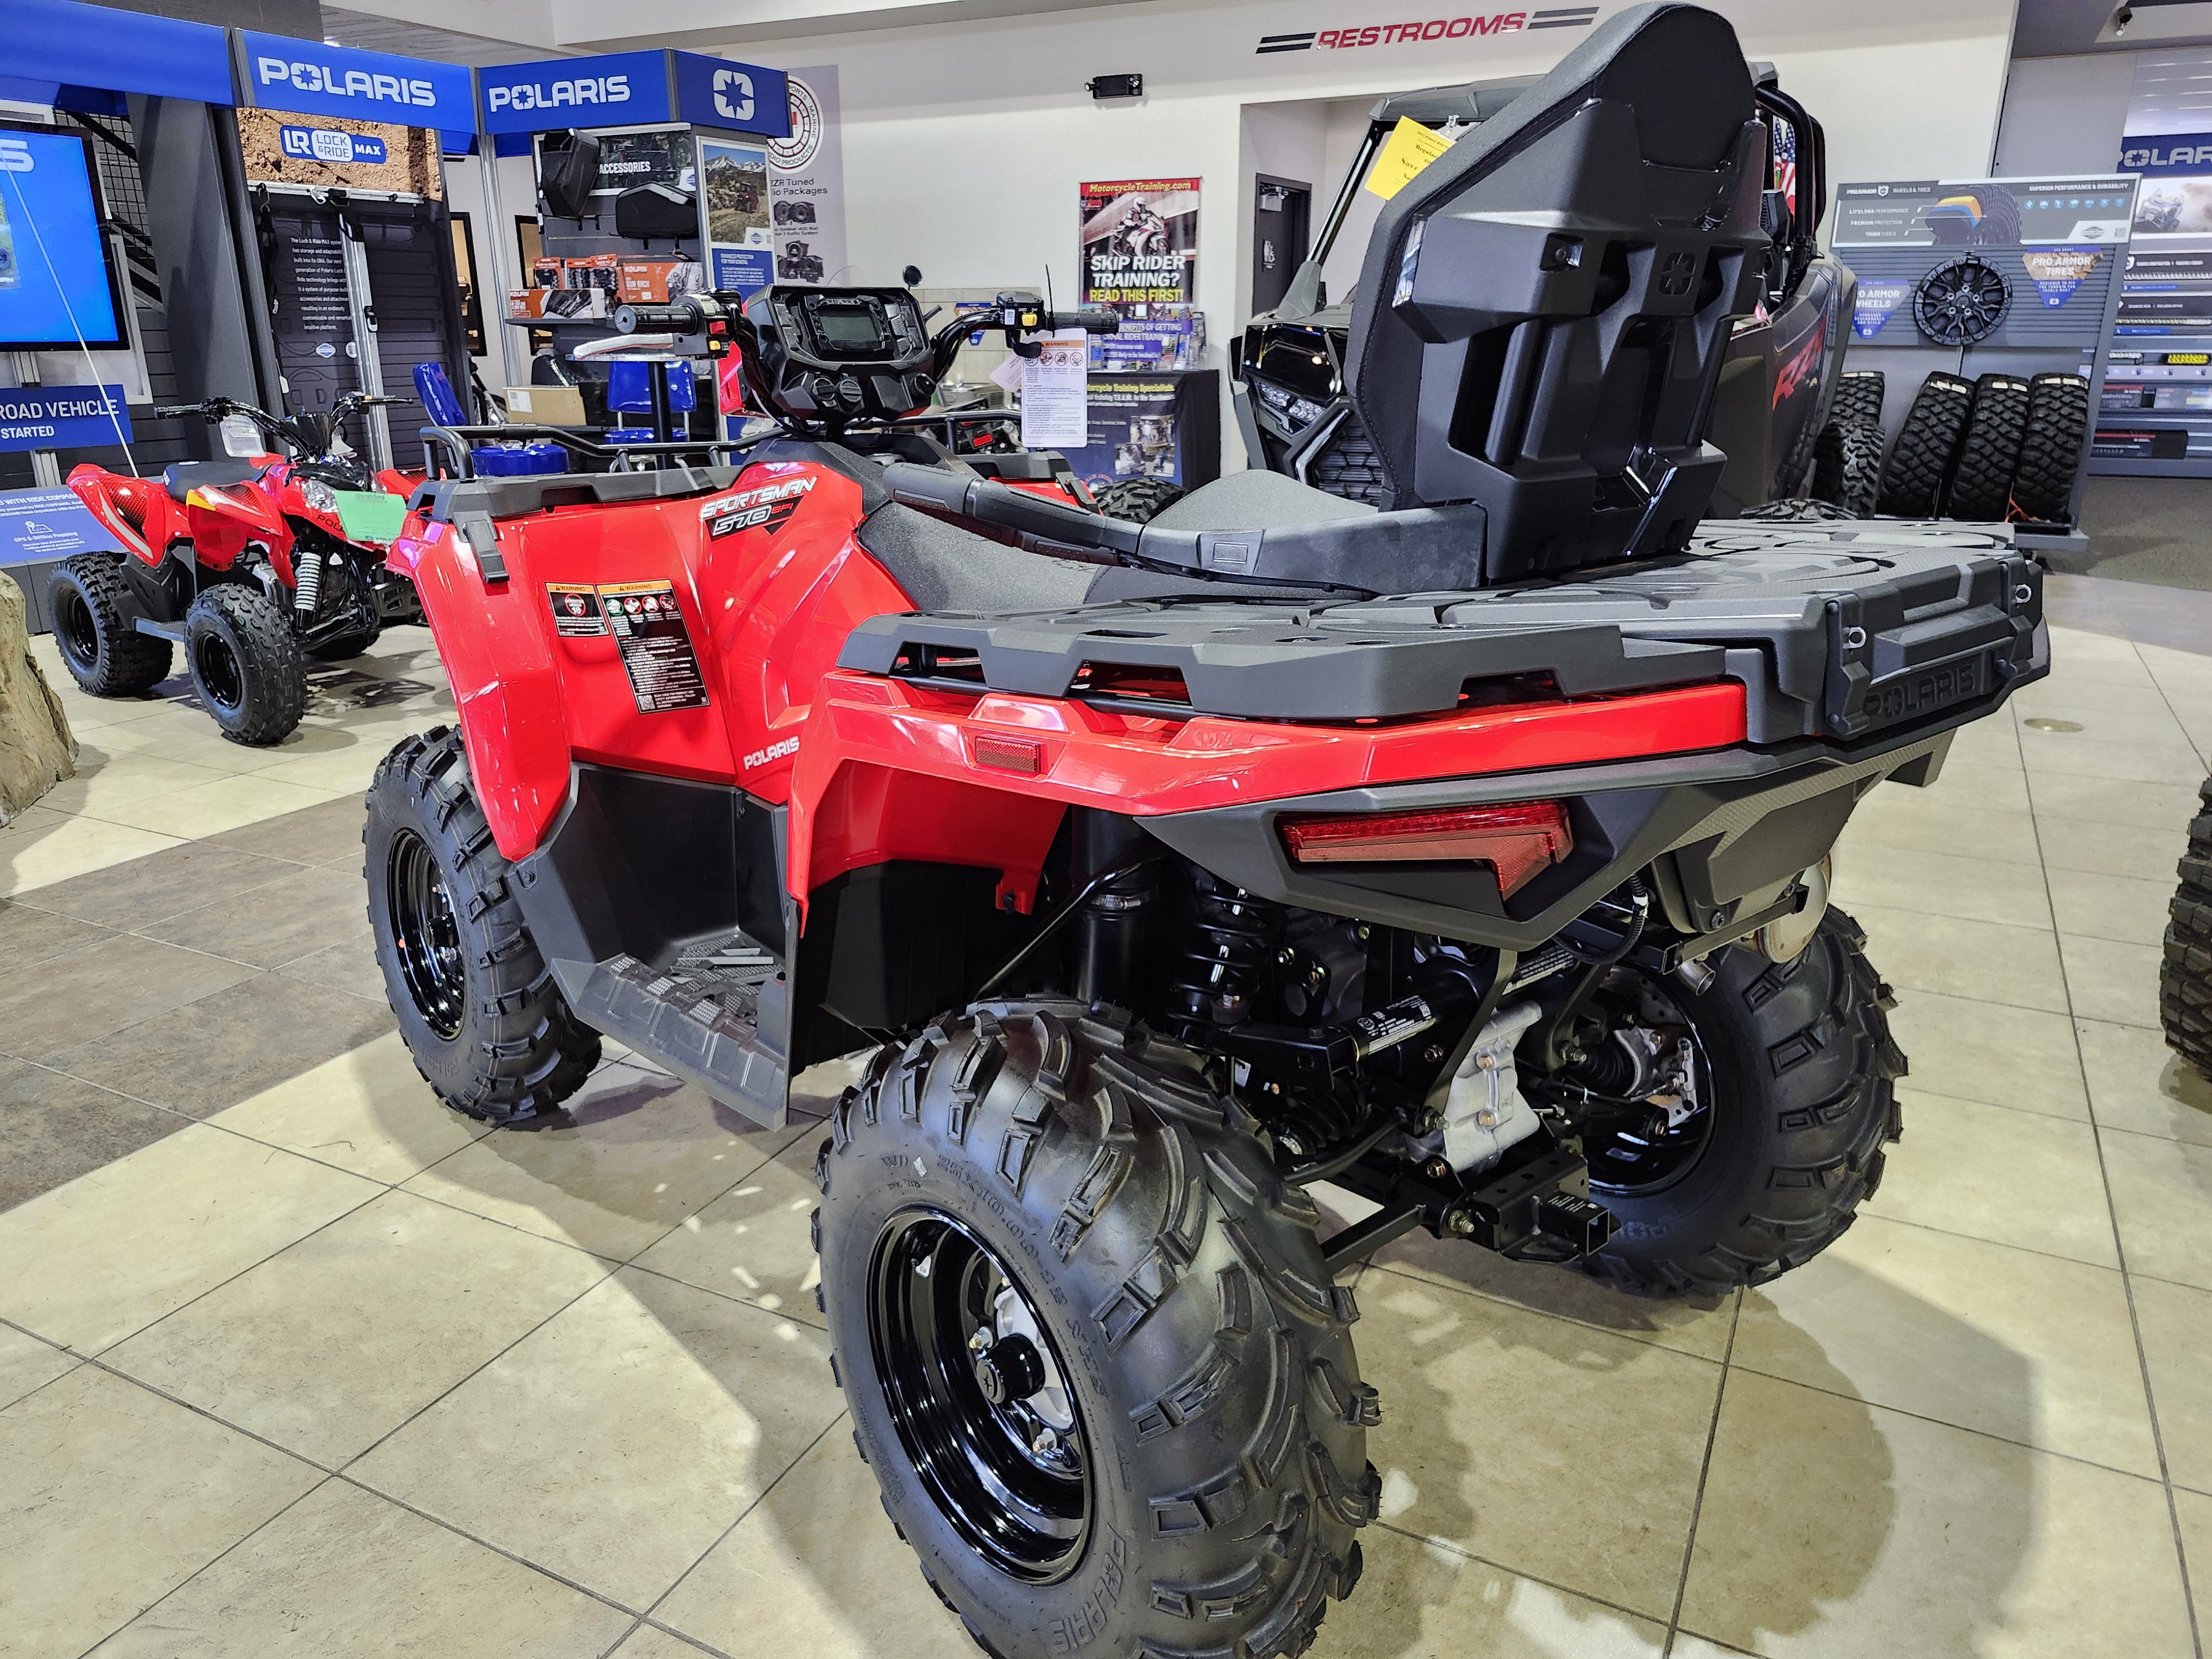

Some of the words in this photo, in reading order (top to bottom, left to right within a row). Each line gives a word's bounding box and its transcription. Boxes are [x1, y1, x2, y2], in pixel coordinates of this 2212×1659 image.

[1316, 12, 1526, 50] RESTROOMS
[258, 56, 436, 107] POLARIS
[488, 75, 630, 112] POLARIS
[808, 105, 817, 138] MARINE
[283, 129, 312, 155] LR
[316, 133, 347, 147] LOCK
[354, 143, 382, 156] MAX
[782, 144, 813, 165] PRODUCTS
[1415, 144, 1437, 158] Regular
[2118, 146, 2212, 167] OLAR
[599, 161, 650, 175] ACCESSORIES
[1401, 158, 1419, 171] Save
[784, 187, 828, 196] Packages
[1089, 181, 1191, 193] MotorcycleTraining.com
[1090, 255, 1130, 271] SKIP
[1133, 255, 1186, 270] RIDER
[2032, 257, 2053, 267] PRO
[2054, 256, 2091, 266] ARMOR
[2046, 267, 2075, 276] TIRES
[1092, 273, 1181, 288] TRAINING?
[1089, 289, 1120, 302] READ
[1121, 289, 1147, 302] THIS
[1148, 289, 1185, 302] FIRST!
[1866, 289, 1901, 298] ARMOR
[1146, 323, 1154, 331] OF
[1155, 323, 1182, 331] GETTING
[45, 399, 119, 418] VEHICLE
[1, 425, 55, 439] STARTED
[4, 497, 28, 505] WITH
[700, 476, 819, 519] SPORTSMAN
[317, 514, 346, 533] POLA
[713, 504, 772, 536] 570
[771, 503, 794, 514] EFI
[1863, 664, 1975, 717] POLARIS
[743, 735, 800, 770] POLARIS
